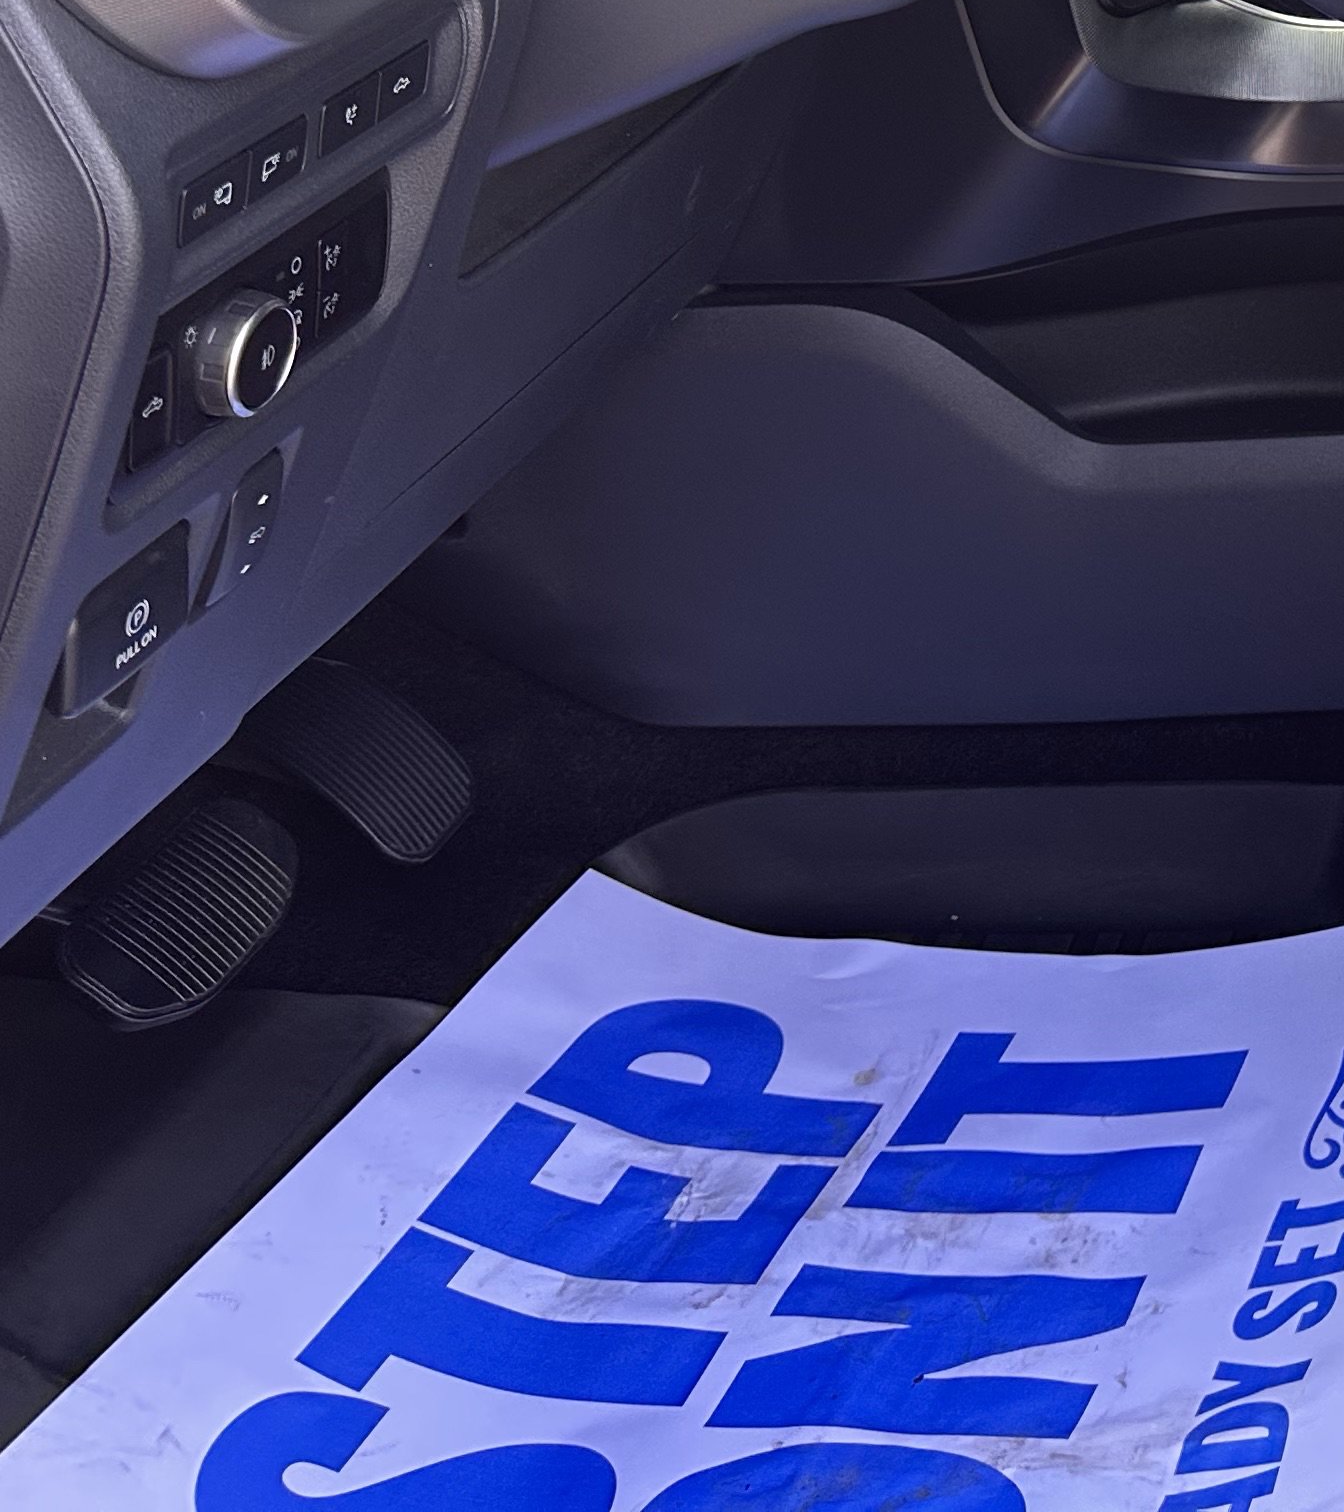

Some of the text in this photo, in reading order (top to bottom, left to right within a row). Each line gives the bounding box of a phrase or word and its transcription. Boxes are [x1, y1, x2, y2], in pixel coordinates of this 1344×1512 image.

[115, 625, 158, 670] PULL ON
[195, 998, 881, 1512] STEP
